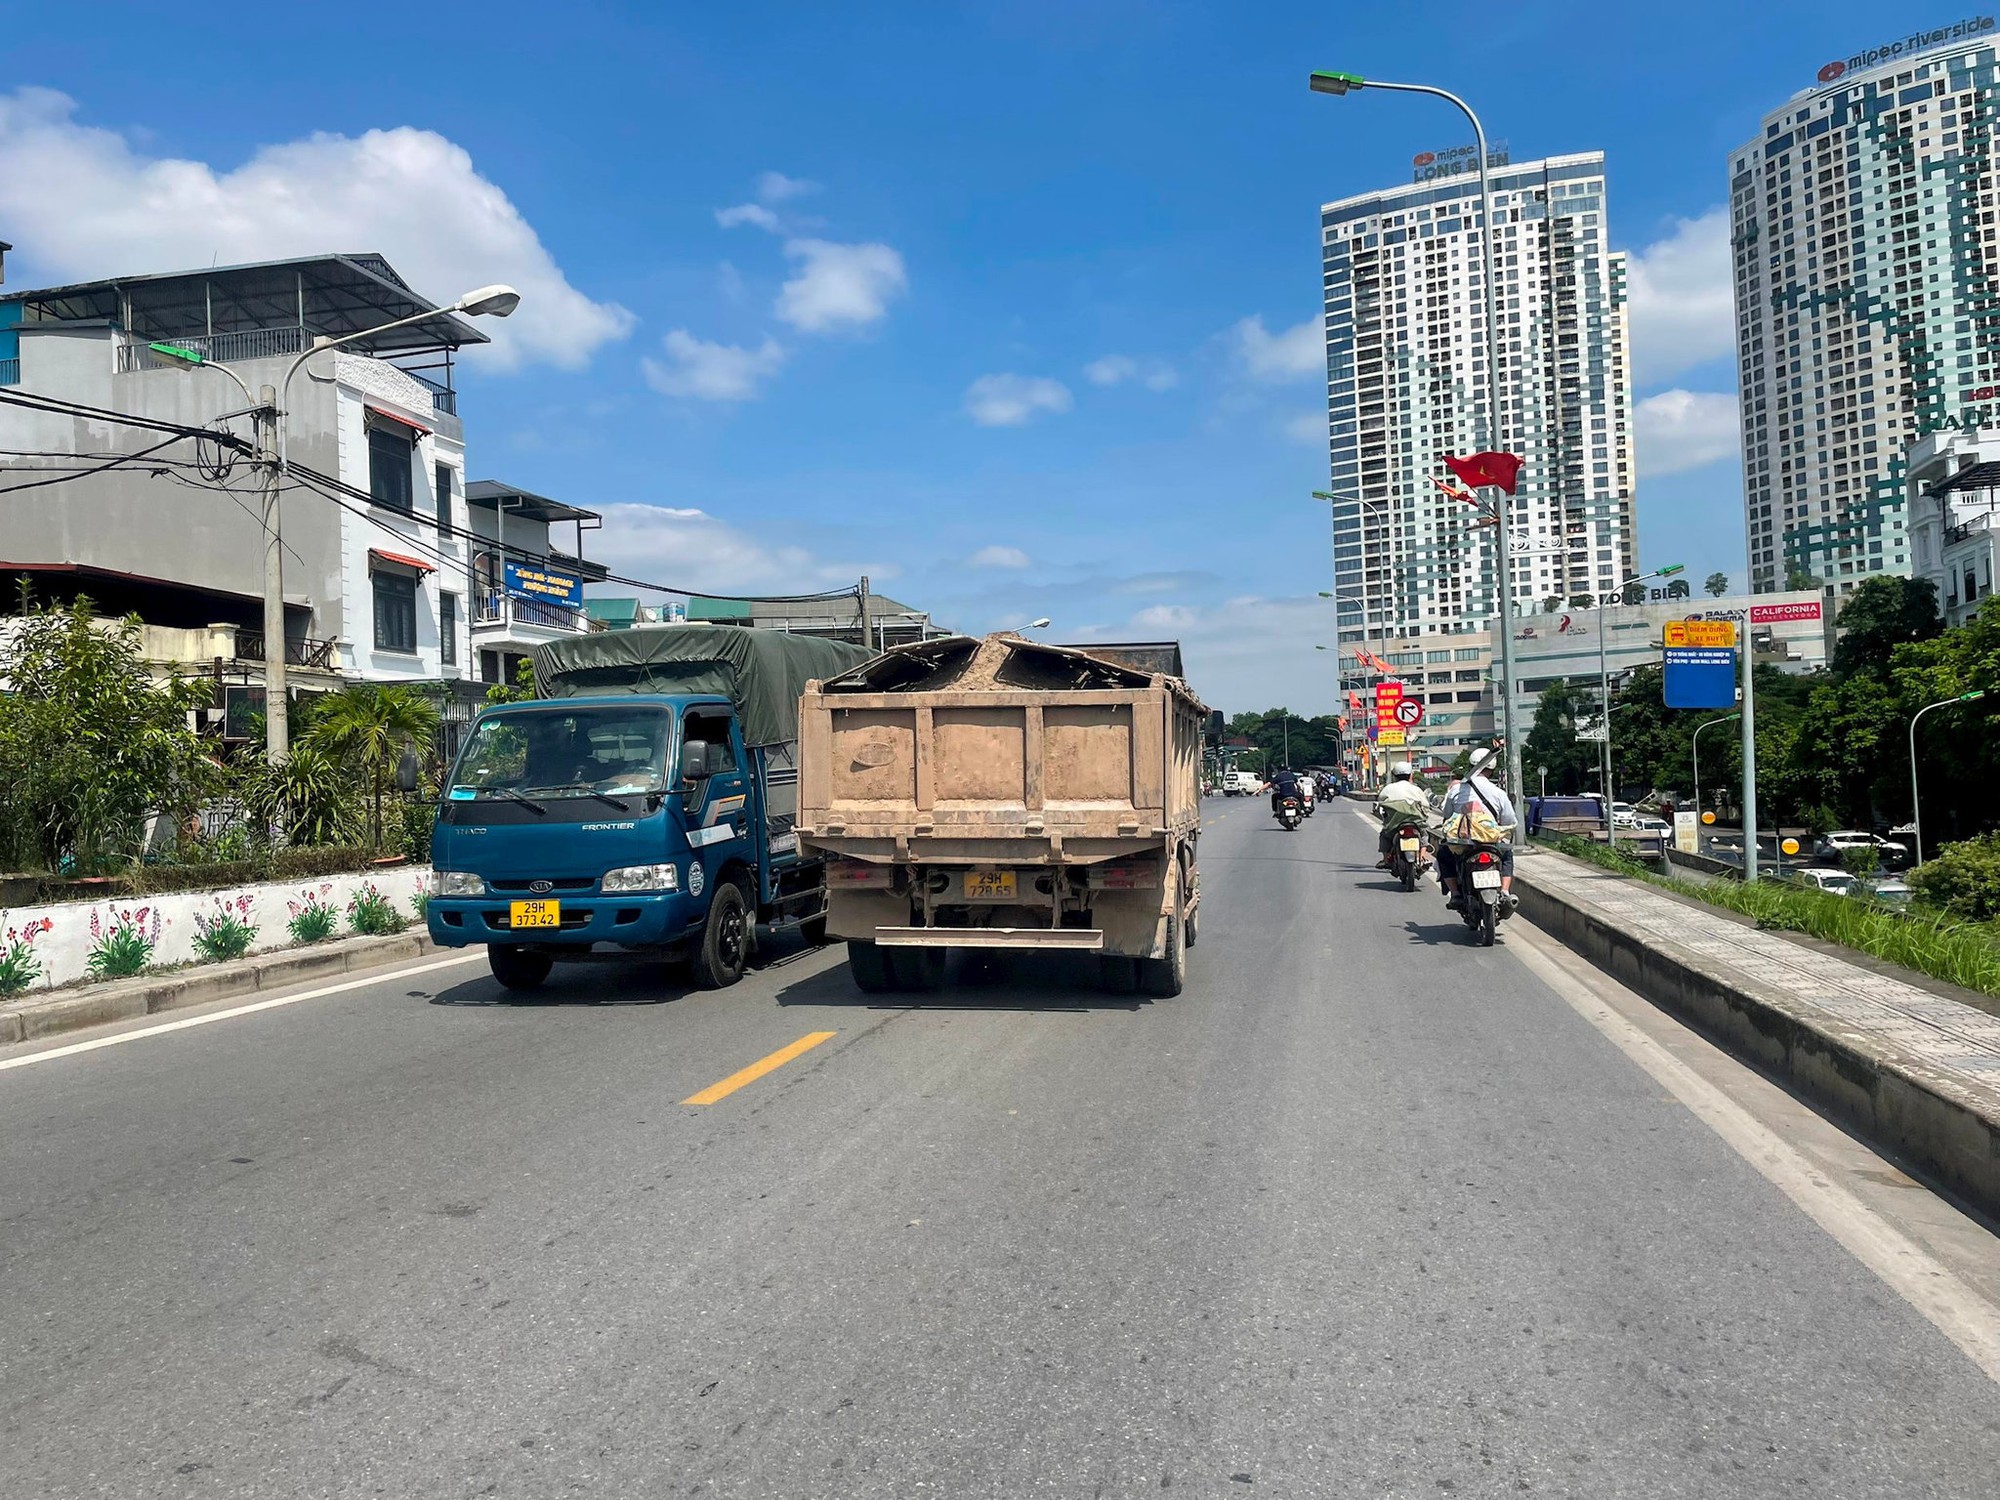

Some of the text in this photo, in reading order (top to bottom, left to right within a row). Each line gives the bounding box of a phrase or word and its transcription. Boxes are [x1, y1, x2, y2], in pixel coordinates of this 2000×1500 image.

[1849, 16, 1995, 69] mipec riverside
[1437, 145, 1475, 161] mipec
[1414, 161, 1462, 183] LONG
[1753, 606, 1817, 616] CALIFORNIA
[582, 822, 635, 831] FRONTIER
[979, 873, 1001, 884] 29H
[524, 902, 545, 914] 29H
[516, 914, 554, 927] 373.42
